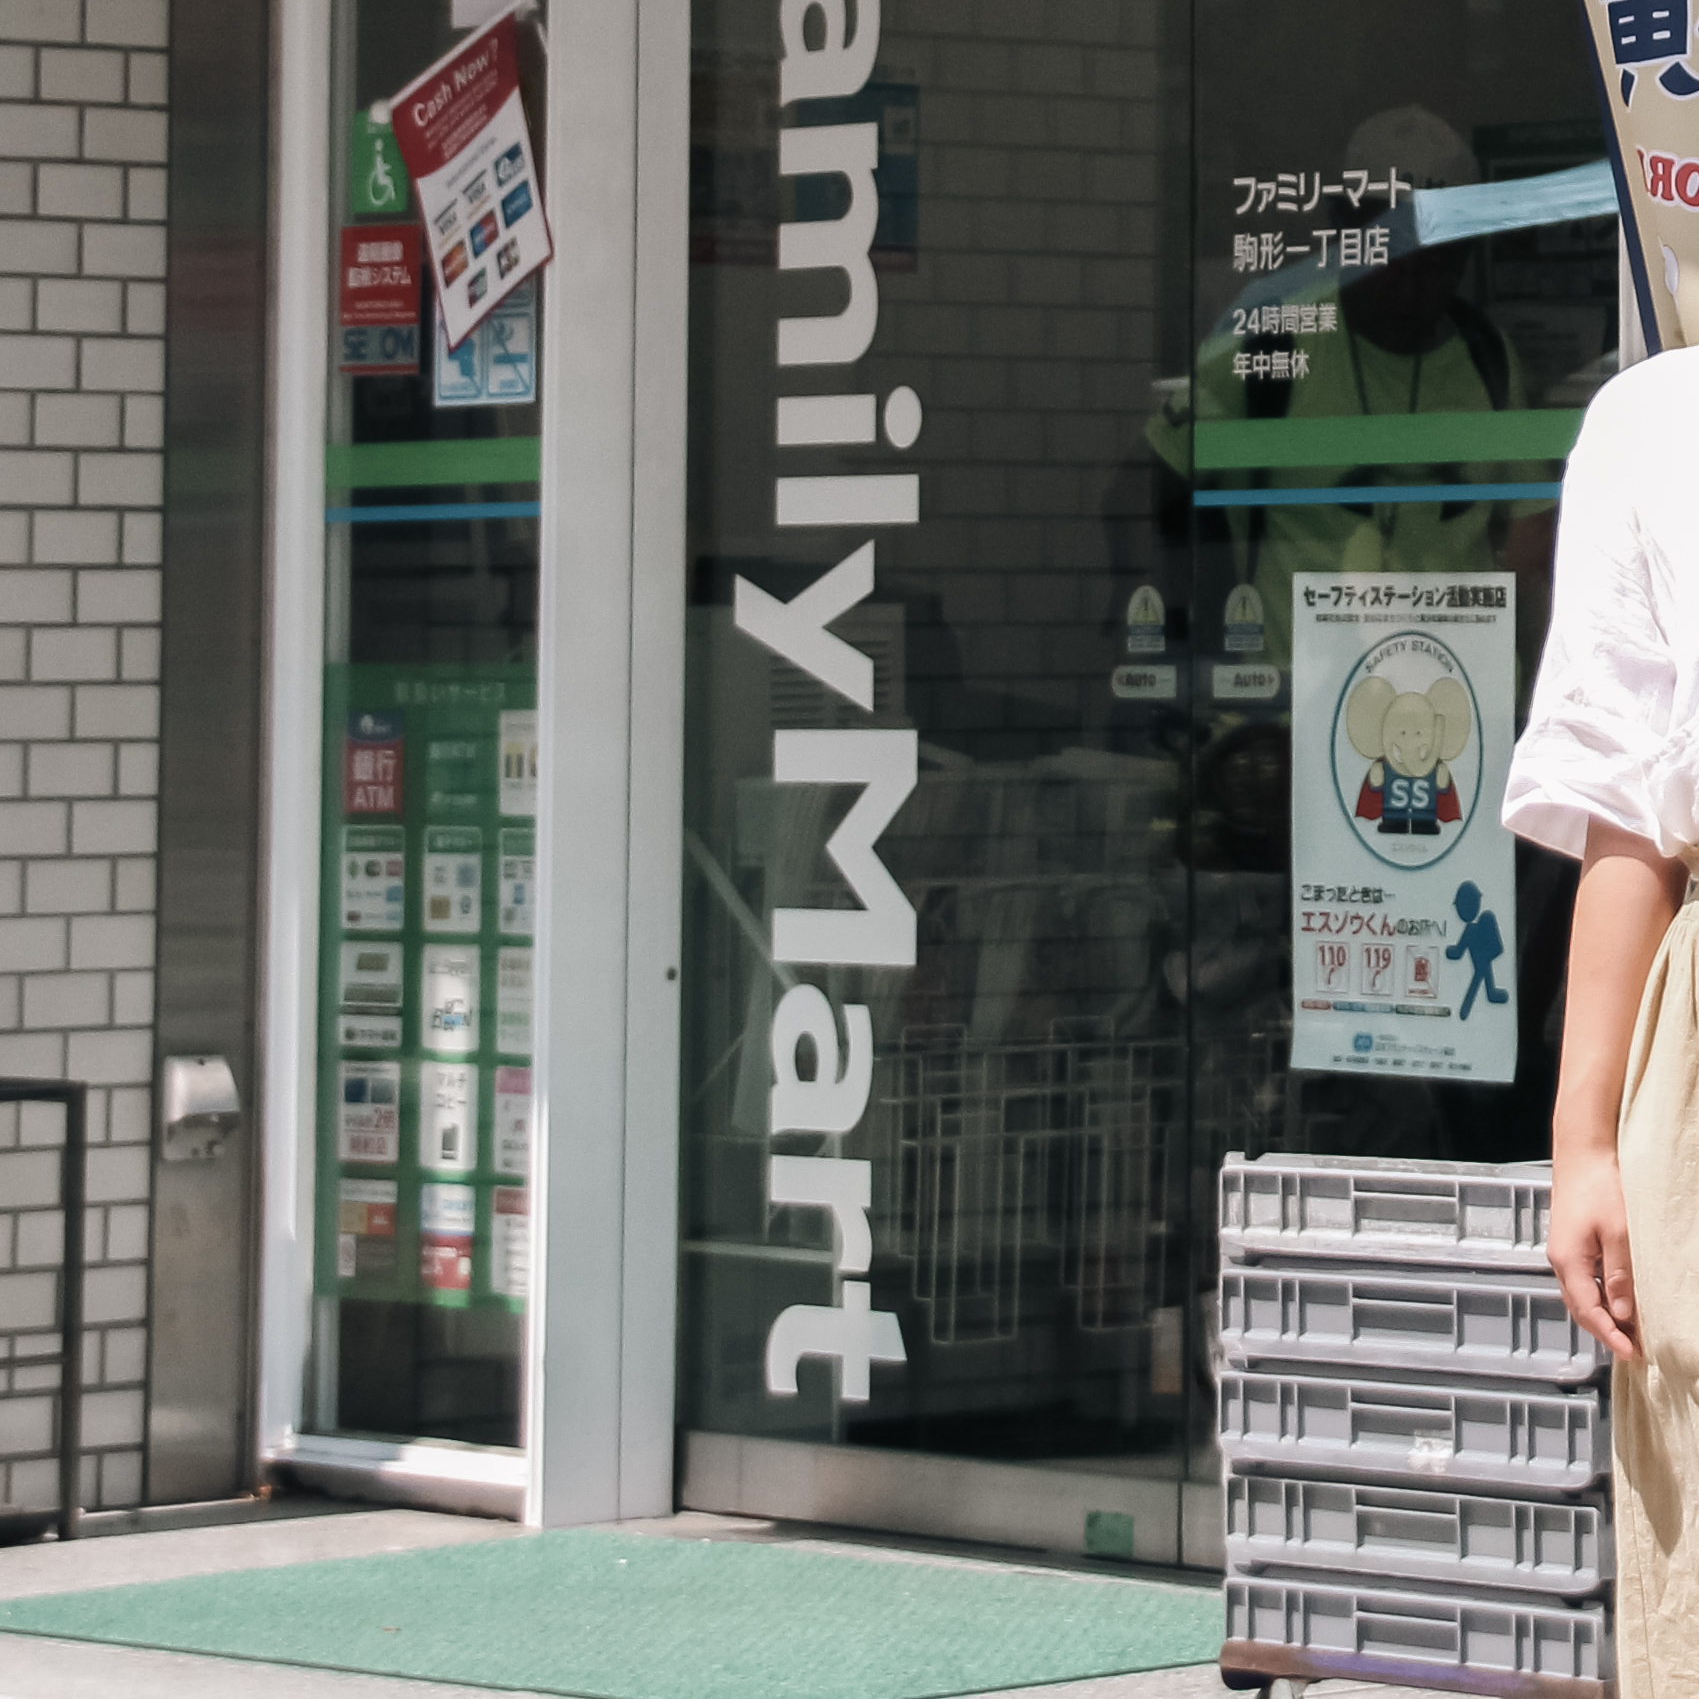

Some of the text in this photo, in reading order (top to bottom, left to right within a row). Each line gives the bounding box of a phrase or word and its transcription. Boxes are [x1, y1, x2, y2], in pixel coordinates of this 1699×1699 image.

[1233, 165, 1412, 215] ファミリーマート
[1233, 226, 1390, 272] 駒形一丁目店
[1233, 303, 1337, 335] 24時間営業
[1233, 349, 1310, 380] 年中無休
[1365, 640, 1455, 674] SAFETY STATION
[354, 786, 395, 809] ATM
[1391, 778, 1430, 808] SS
[1318, 944, 1392, 970] 110 119
